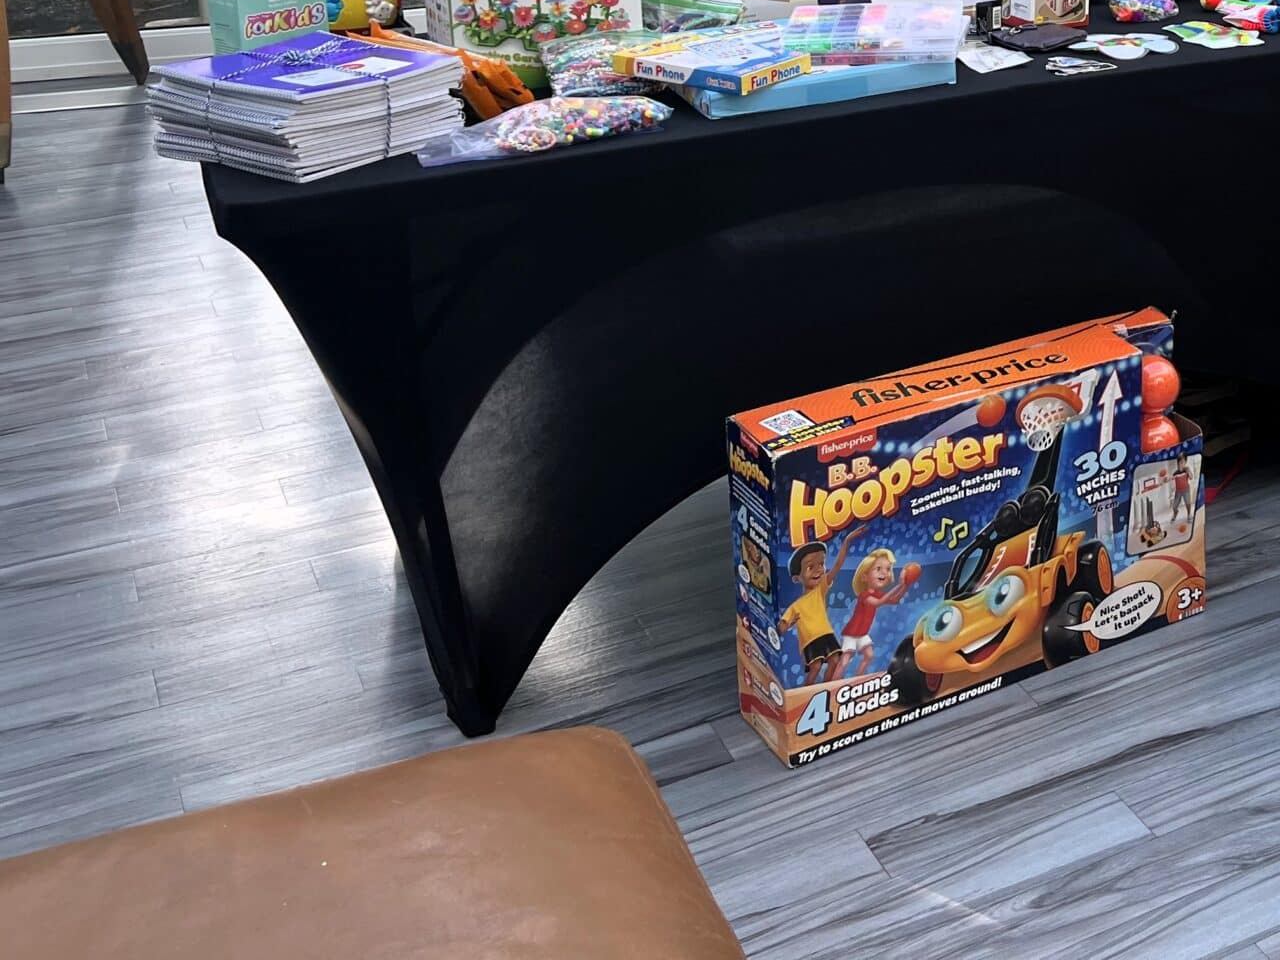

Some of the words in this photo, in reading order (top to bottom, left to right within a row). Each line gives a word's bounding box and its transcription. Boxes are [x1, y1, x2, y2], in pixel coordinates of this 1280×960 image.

[636, 61, 653, 75] Fun
[655, 66, 685, 81] Phone
[750, 75, 768, 90] Fun
[770, 62, 801, 83] Phone
[850, 352, 1069, 407] fisher-price
[820, 434, 874, 455] fisher-price
[828, 455, 878, 488] B.B.
[1073, 440, 1128, 483] 30
[789, 432, 1003, 548] Hoopster
[909, 480, 960, 508] Zooming,
[961, 466, 1022, 489] fast-talking,
[911, 488, 966, 516] basketball
[965, 479, 1002, 500] buddy!
[1076, 468, 1127, 498] INCHES
[1085, 485, 1118, 504] TALL!
[1094, 614, 1118, 628] Let's
[1119, 593, 1155, 618] baaack
[1100, 602, 1121, 617] Nice
[1121, 586, 1146, 607] Shot!
[1177, 587, 1203, 610] 3+
[1123, 612, 1141, 628] up!
[836, 673, 893, 704] Game
[837, 687, 900, 723] Modes
[796, 690, 831, 737] 4
[798, 749, 817, 764] Try
[818, 743, 832, 756] to
[832, 730, 864, 750] score
[864, 725, 879, 739] as
[880, 716, 900, 731] the
[900, 708, 920, 724] net
[920, 695, 957, 717] moves
[958, 676, 1003, 702] around!
